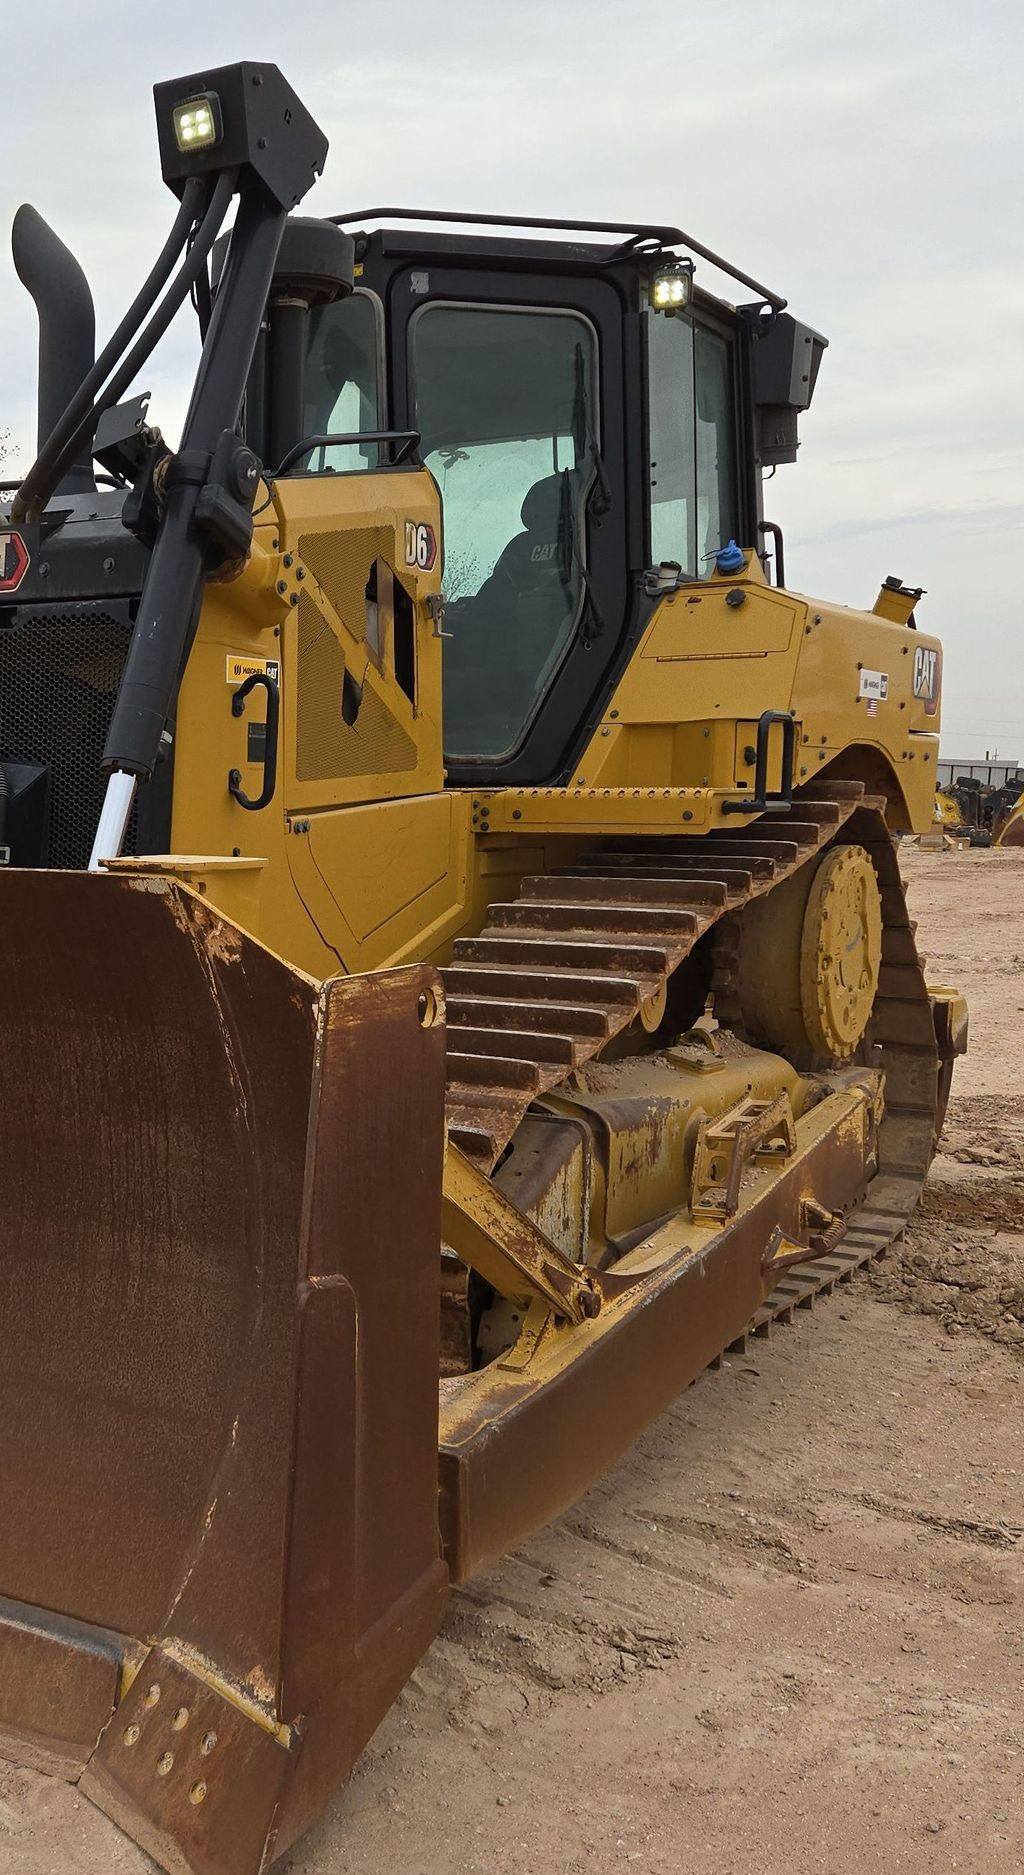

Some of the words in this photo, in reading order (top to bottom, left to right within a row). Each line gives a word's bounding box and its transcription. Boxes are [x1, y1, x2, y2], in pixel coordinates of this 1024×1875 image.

[405, 522, 428, 567] D6
[530, 543, 558, 562] CAT
[913, 647, 936, 699] CAT
